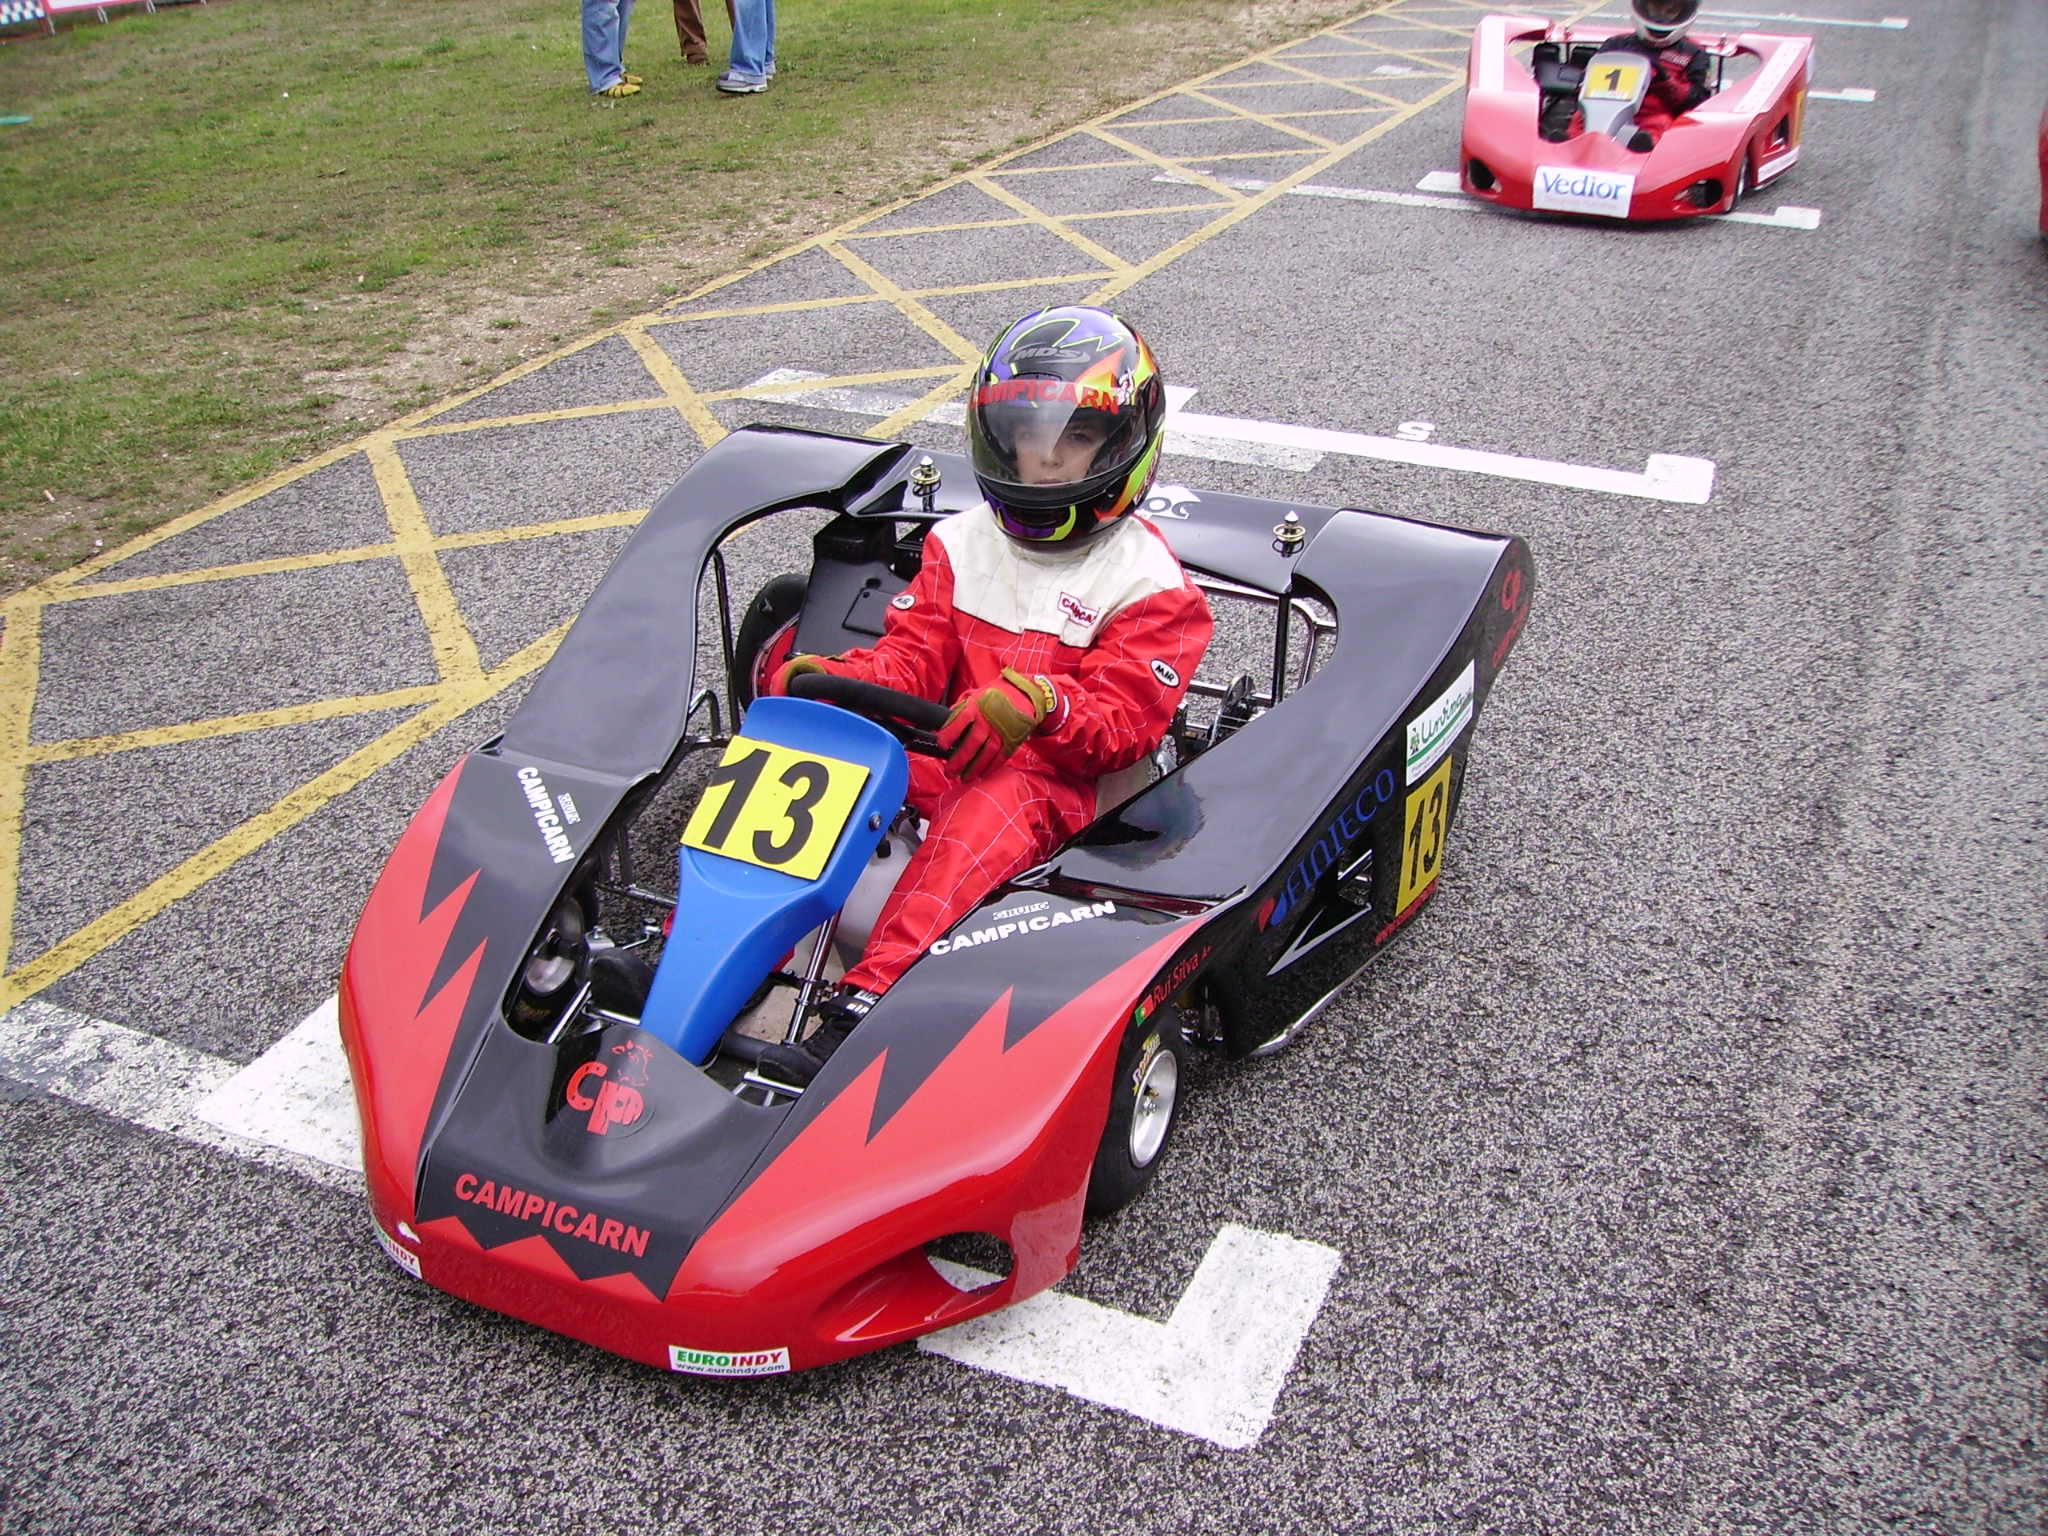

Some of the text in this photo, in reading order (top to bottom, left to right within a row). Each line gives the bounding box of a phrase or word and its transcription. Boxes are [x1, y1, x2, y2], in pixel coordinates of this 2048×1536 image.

[1604, 68, 1622, 91] 1
[1543, 171, 1626, 200] Vedior
[517, 767, 575, 863] CAMPICARN
[702, 748, 829, 865] 13
[1408, 781, 1443, 890] 13
[929, 900, 1117, 956] CAMPICARN
[455, 1173, 651, 1258] CAMPICARN
[675, 1362, 785, 1375] www.euroindy.com
[676, 1349, 783, 1367] EUROINDY
